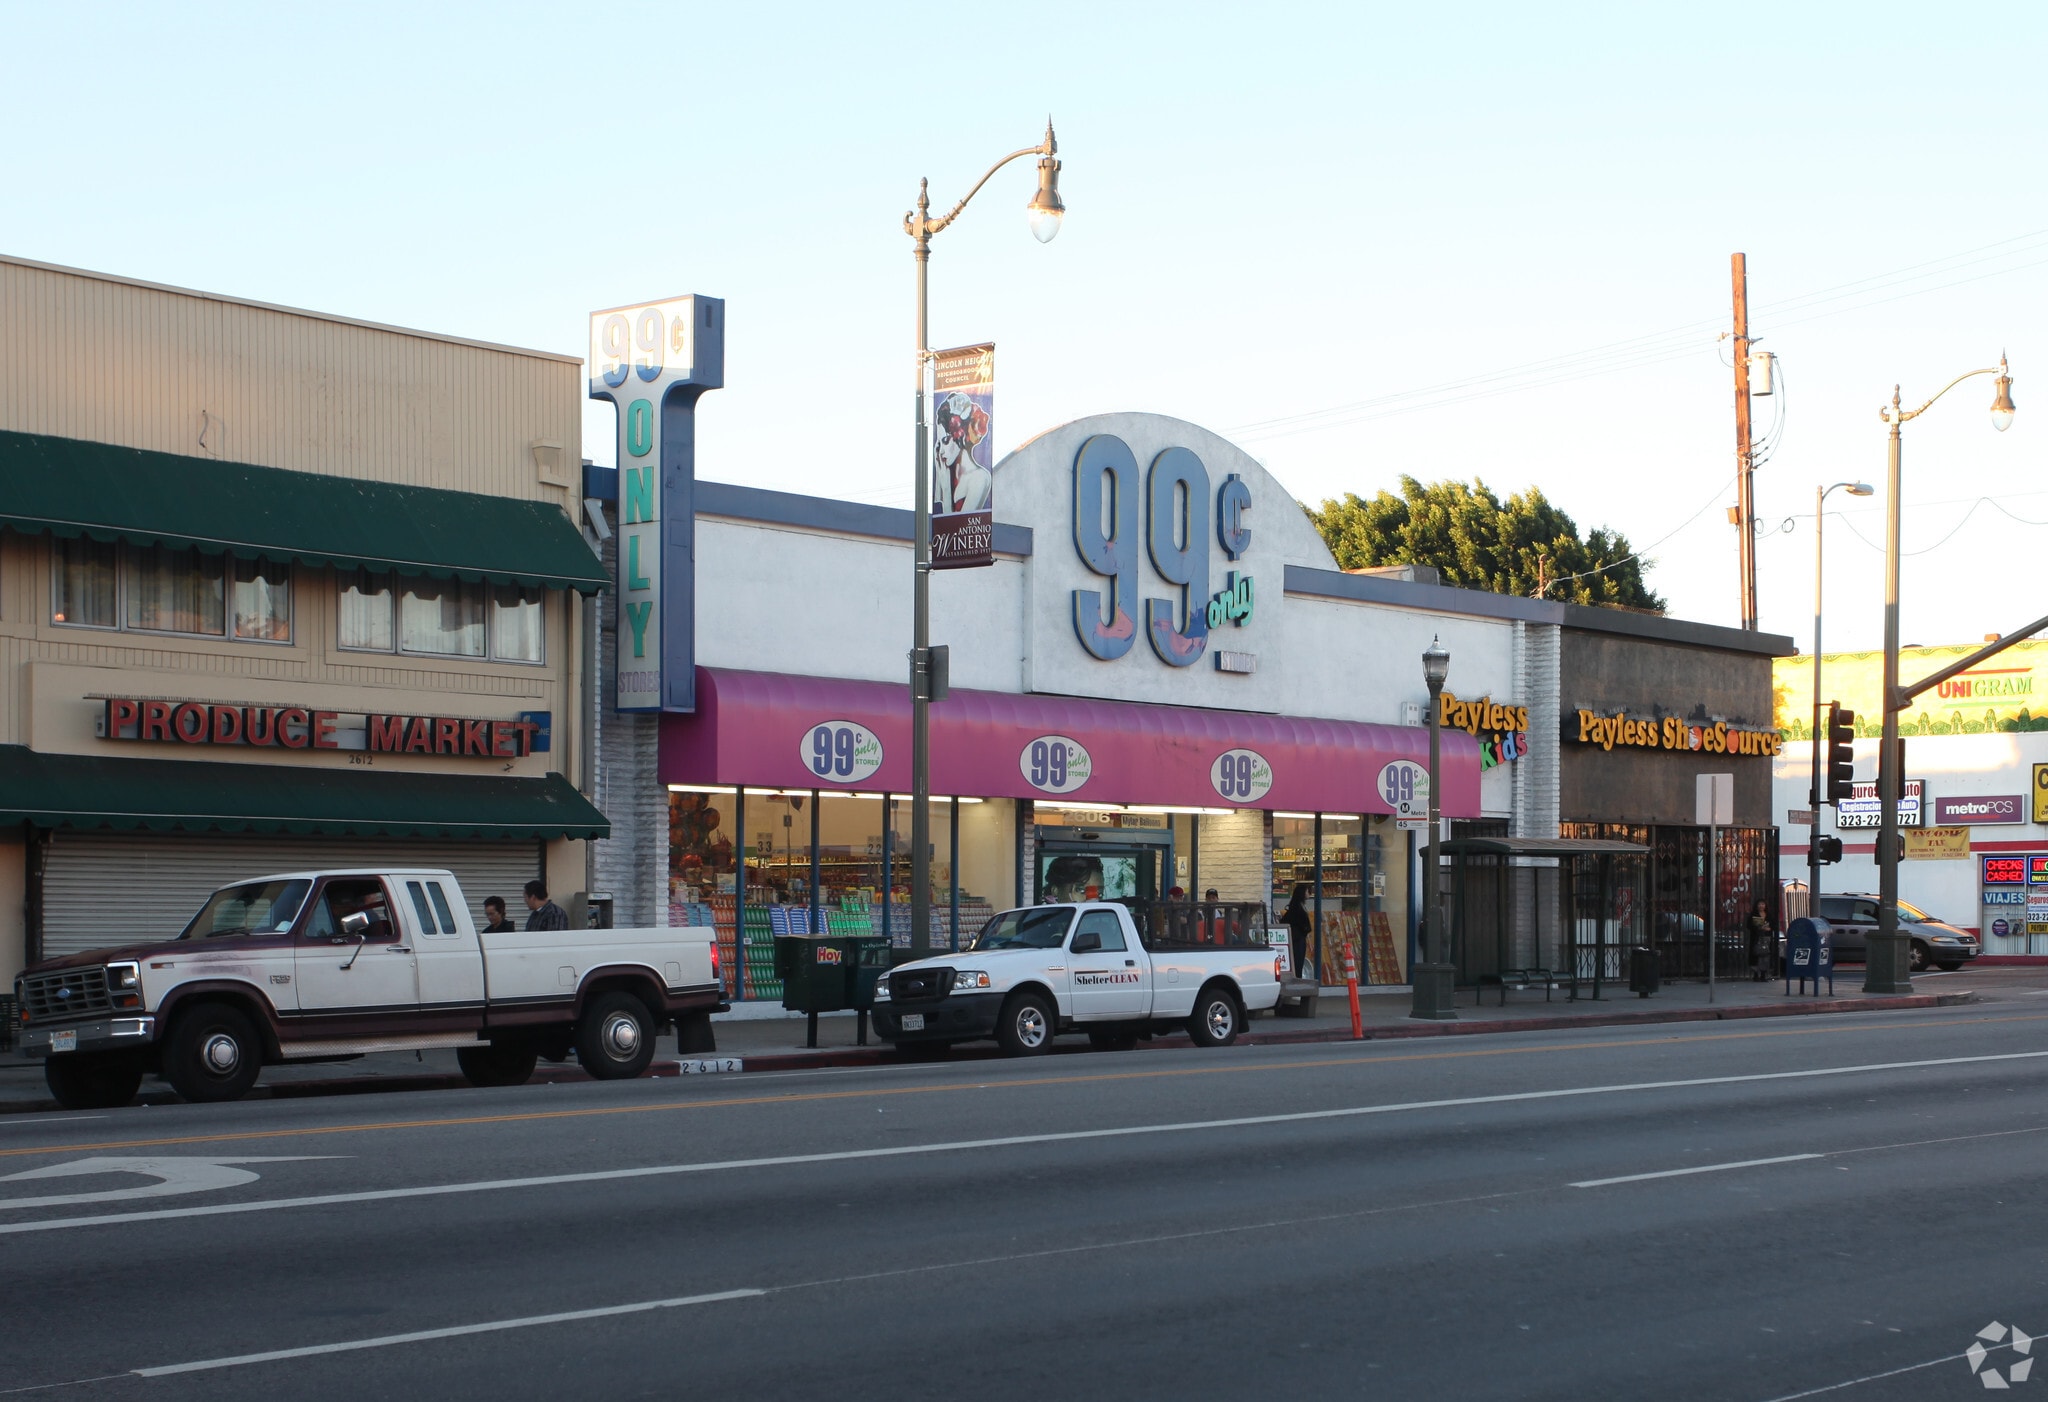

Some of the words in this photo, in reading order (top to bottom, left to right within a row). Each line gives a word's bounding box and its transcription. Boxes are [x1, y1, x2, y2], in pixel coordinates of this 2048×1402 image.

[935, 359, 963, 371] LINCOLN
[945, 375, 970, 384] COUNCIL
[968, 517, 981, 526] SAN
[626, 398, 654, 658] ONLY
[958, 525, 991, 535] ANTONIO
[945, 549, 979, 558] ESTABLISHED
[1206, 570, 1254, 629] only
[618, 670, 660, 693] STORES
[1938, 677, 2033, 699] UNIGRAM
[1439, 692, 1529, 736] Payless
[105, 699, 339, 750] PRODUCE
[366, 714, 540, 757] MARKET
[1578, 709, 1659, 751] Payless
[855, 738, 879, 756] only
[349, 754, 374, 766] 2612
[855, 758, 880, 766] STORES
[1067, 752, 1088, 769] only
[1068, 770, 1089, 778] STORES
[1252, 764, 1269, 780] only
[1901, 801, 1918, 811] Auto
[1945, 800, 2014, 815] metroPCS
[1063, 809, 1111, 824] 2606
[1398, 820, 1408, 828] 45
[1986, 860, 2024, 870] CHECKS
[1986, 871, 2024, 881] CASHED
[1984, 892, 2024, 904] VIAJES
[817, 946, 842, 965] Hoy
[1076, 973, 1139, 985] ShelterCLEAN
